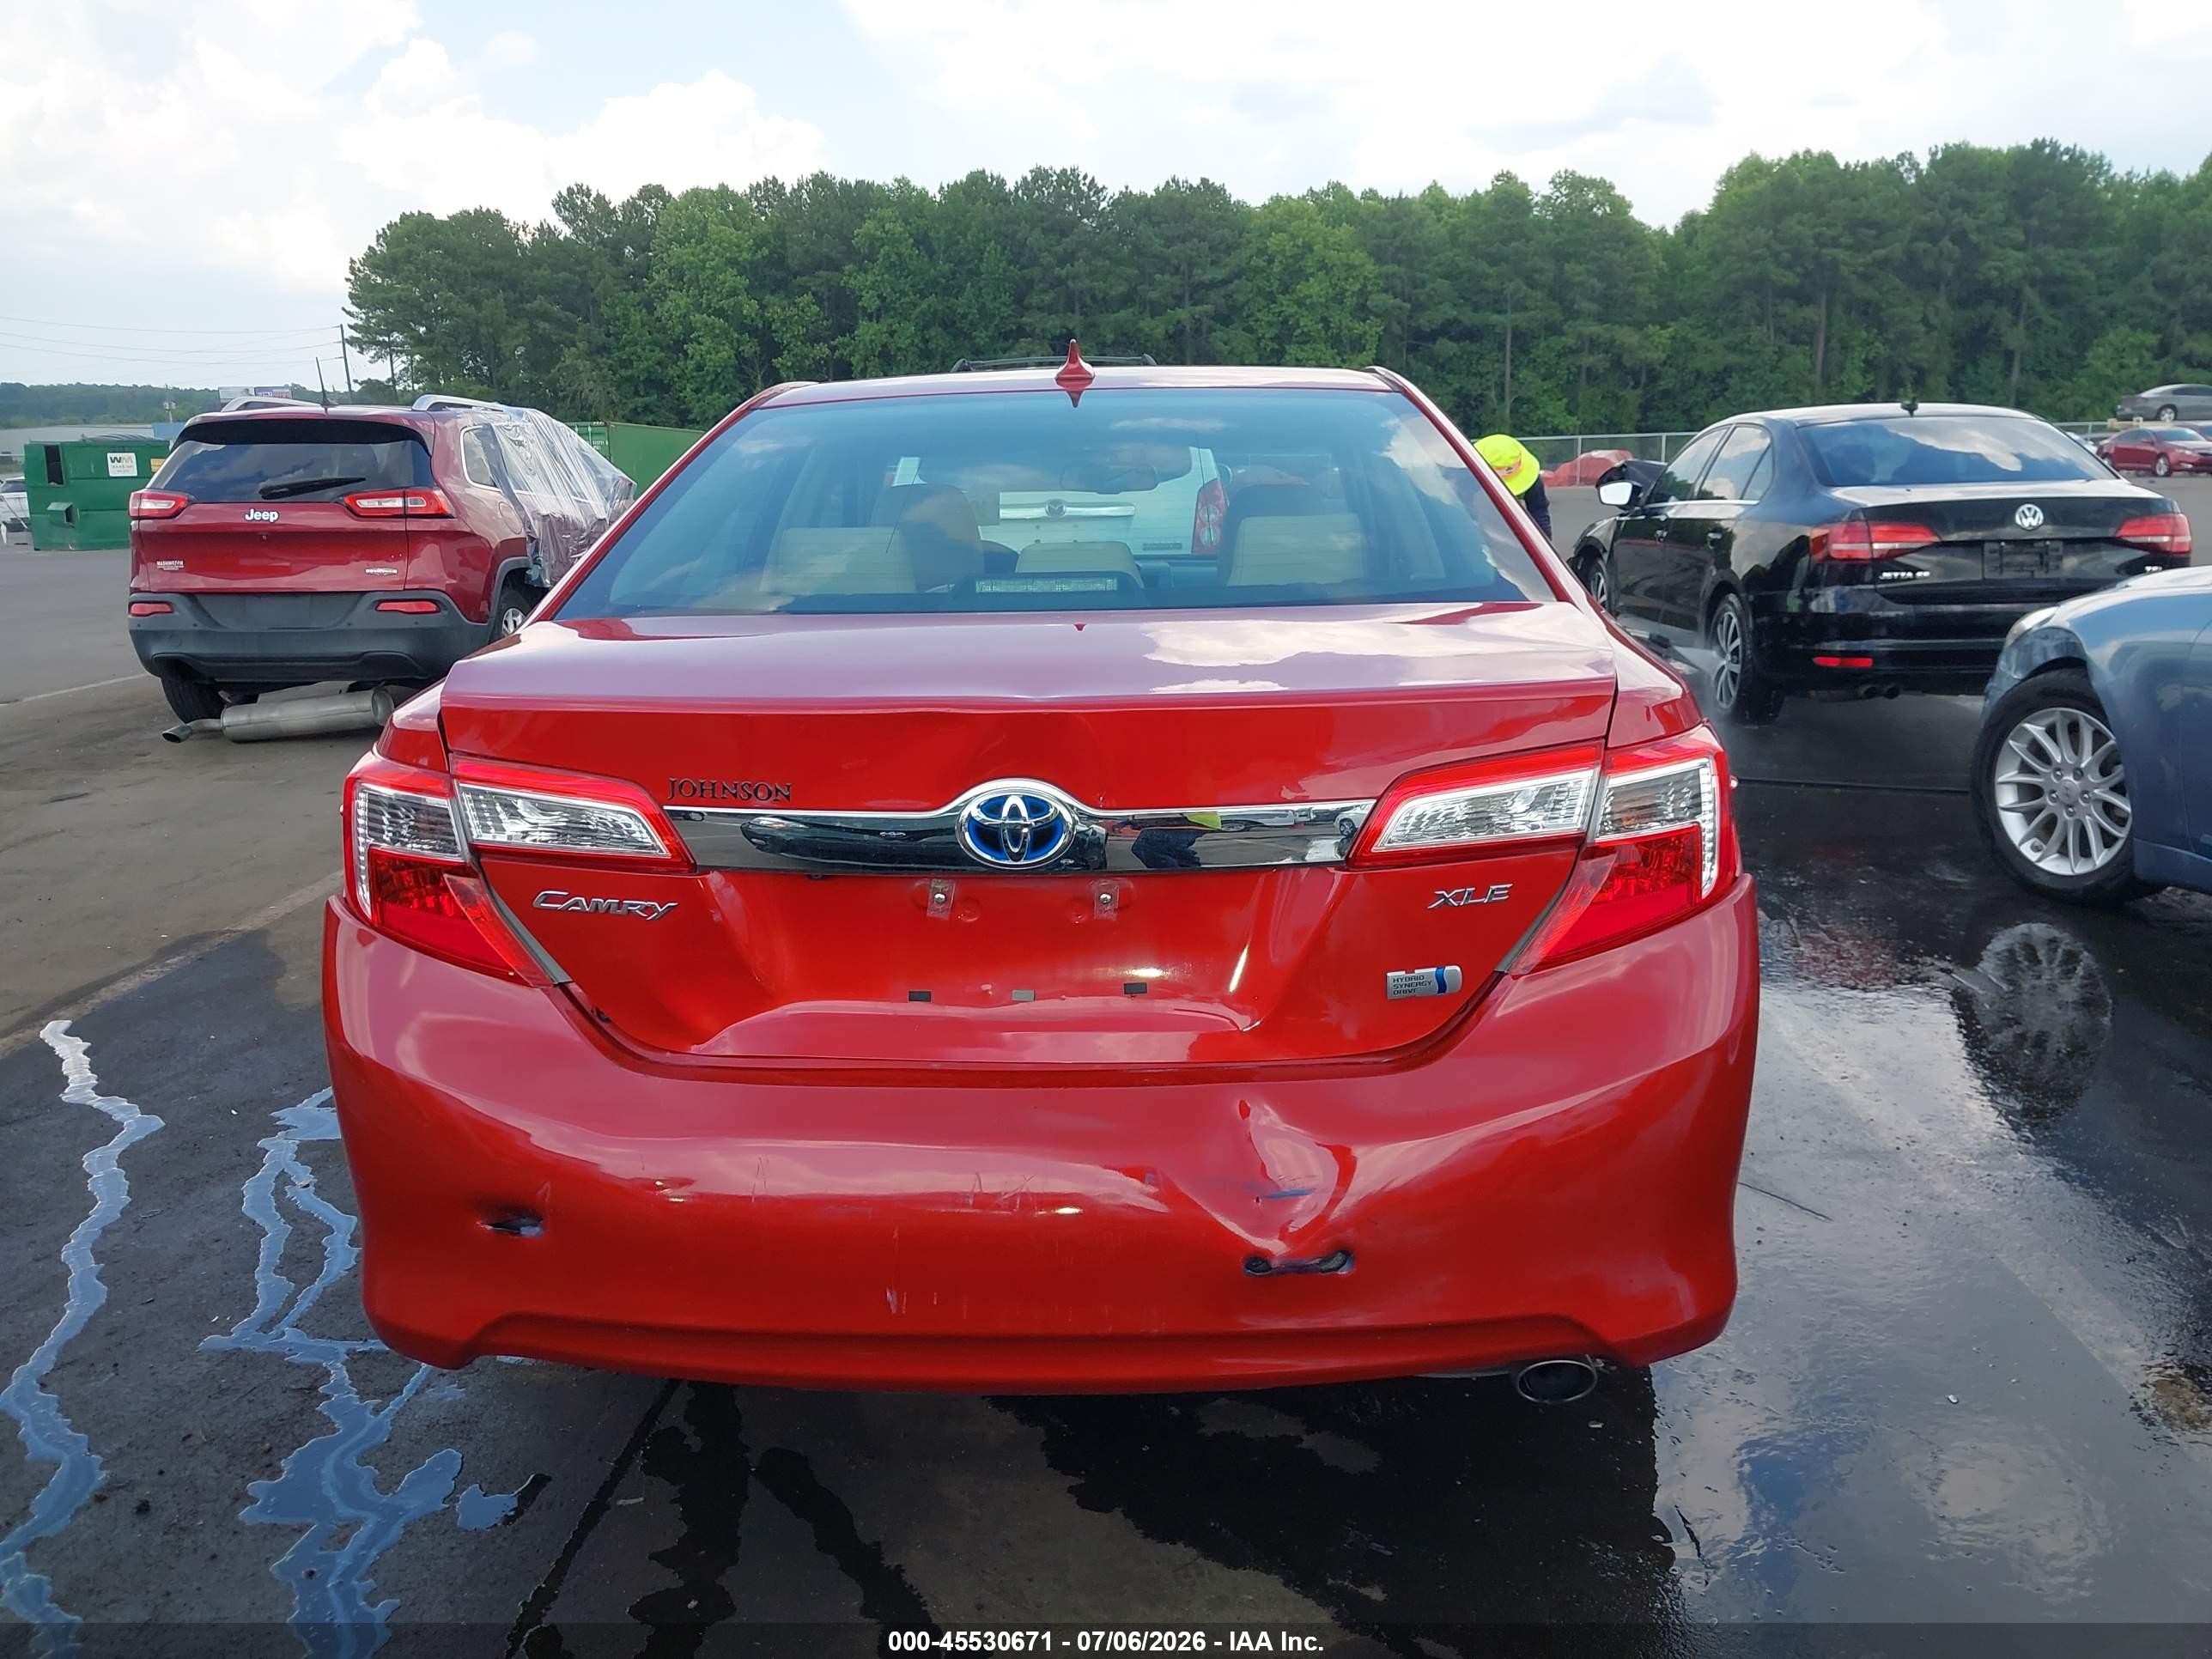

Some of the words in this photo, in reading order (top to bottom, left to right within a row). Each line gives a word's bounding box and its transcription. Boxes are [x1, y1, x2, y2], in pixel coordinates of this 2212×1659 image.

[245, 508, 279, 523] Jeep
[1879, 571, 1913, 580] JETTA
[667, 777, 792, 802] JOHNSON
[1427, 883, 1514, 909] XLE
[532, 890, 678, 921] CAMRY
[1393, 975, 1425, 983] HYBRID
[1393, 981, 1432, 990] SYNERGY
